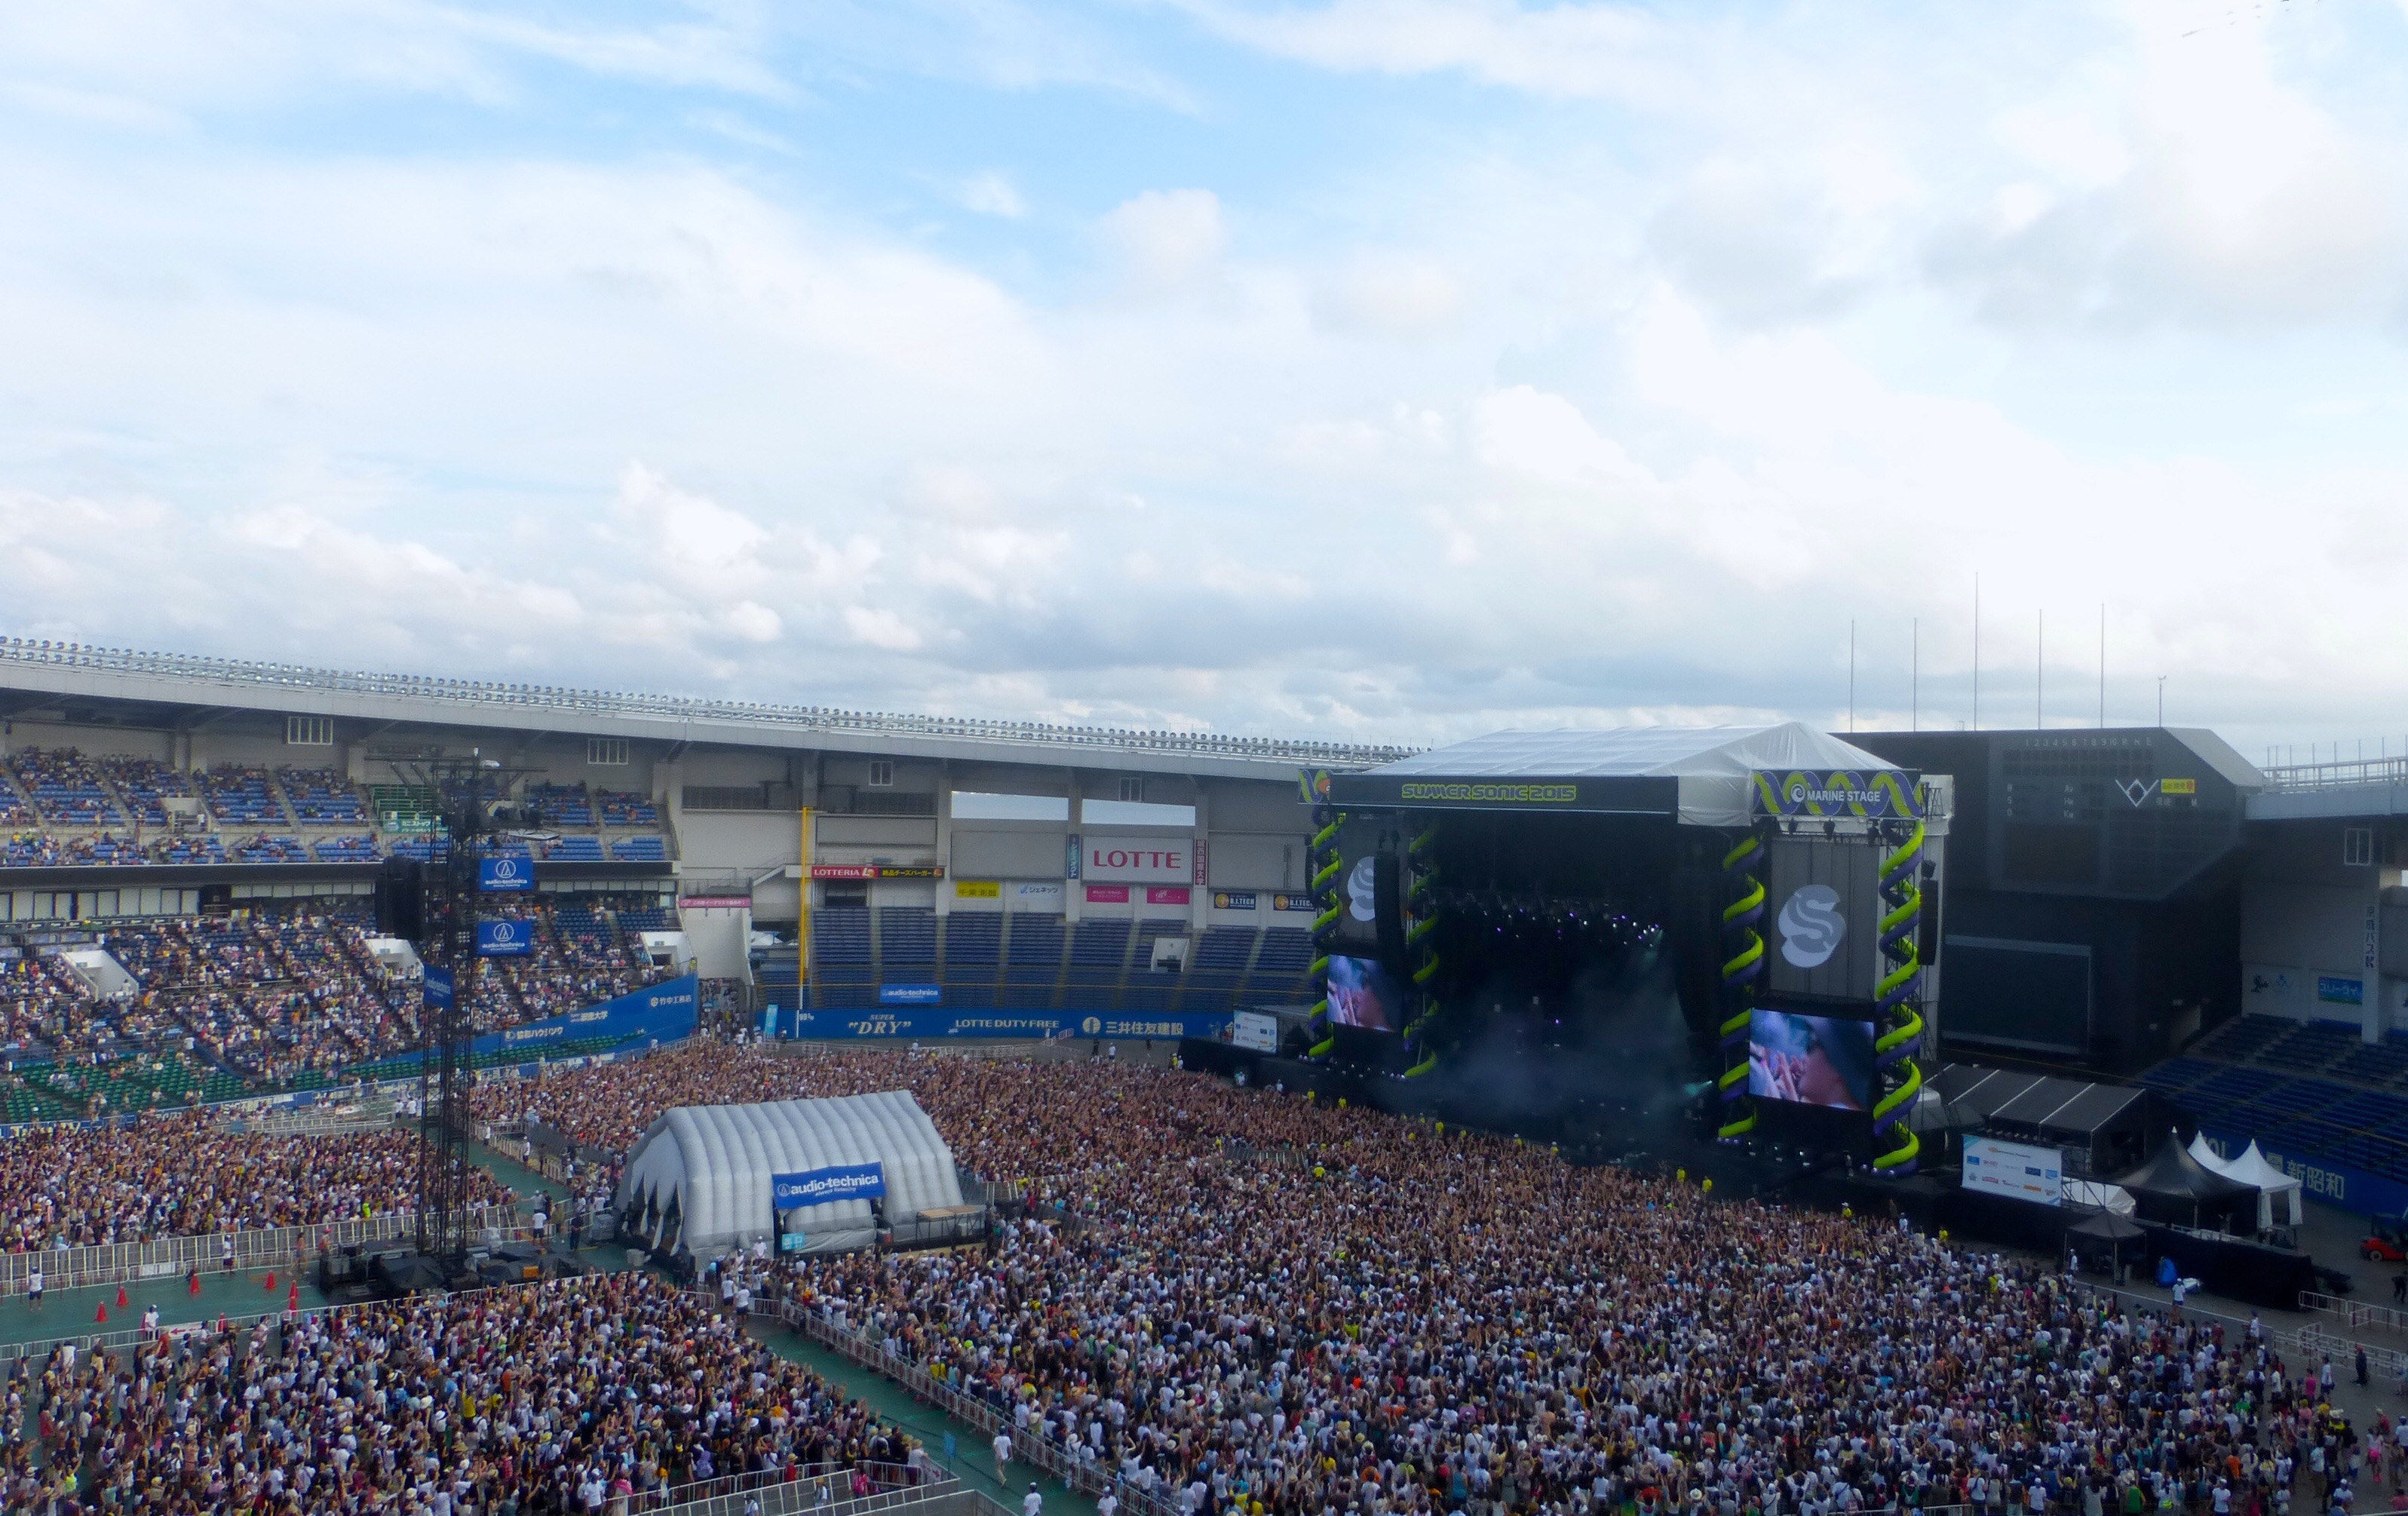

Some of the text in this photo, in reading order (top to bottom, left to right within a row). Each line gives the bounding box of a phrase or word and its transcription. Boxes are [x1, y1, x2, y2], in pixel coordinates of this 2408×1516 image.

[1472, 785, 1529, 801] SONIC
[1529, 785, 1577, 802] 2015
[1807, 790, 1881, 802] MARINE STAGE
[1094, 850, 1181, 868] LOTTE
[956, 1020, 1060, 1029] LOTTE DUTY FREE
[1106, 1021, 1184, 1036] 三井住友建設
[790, 1174, 879, 1194] audio-technica
[2287, 1159, 2345, 1200] 新昭和
